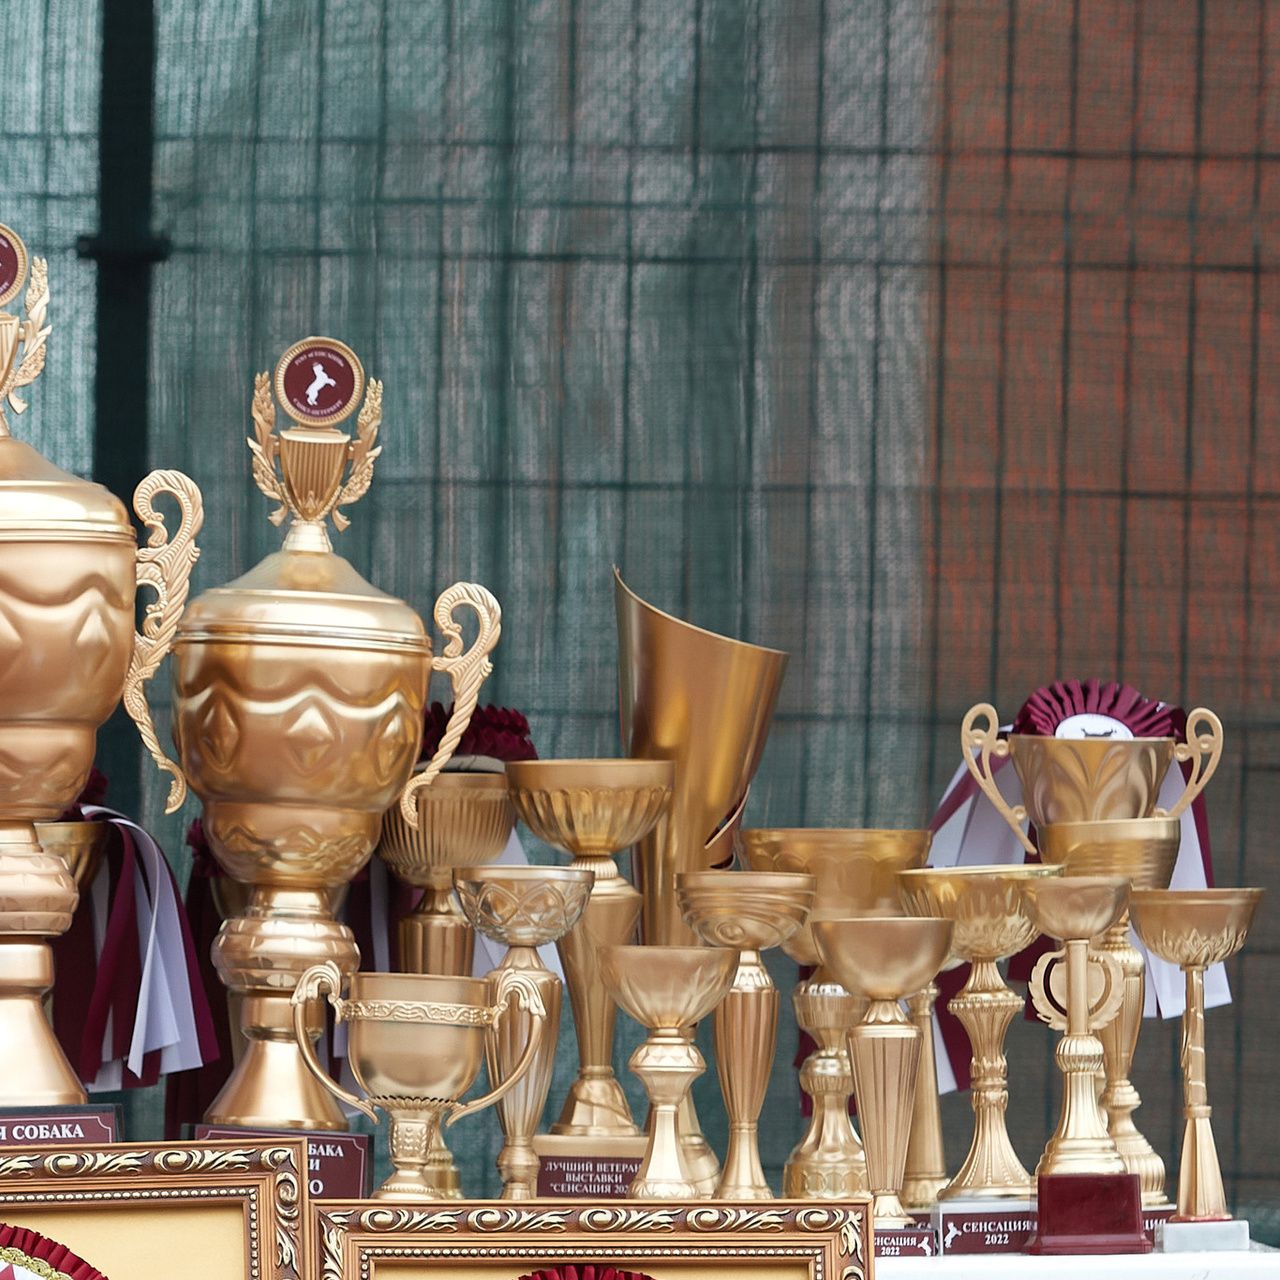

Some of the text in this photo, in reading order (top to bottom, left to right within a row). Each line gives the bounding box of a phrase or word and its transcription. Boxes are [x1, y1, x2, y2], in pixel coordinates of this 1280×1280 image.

[12, 1124, 85, 1140] СОБАКА
[308, 1143, 345, 1157] БАКА
[545, 1161, 593, 1171] ЛУЧШИЙ
[565, 1173, 623, 1183] ВЫСТАВКИ
[962, 1221, 1030, 1233] СЕНСАЦИЯ
[874, 1236, 917, 1246] ЕНСАЦИЯ
[984, 1234, 1010, 1245] 2022
[881, 1247, 901, 1255] 2022
